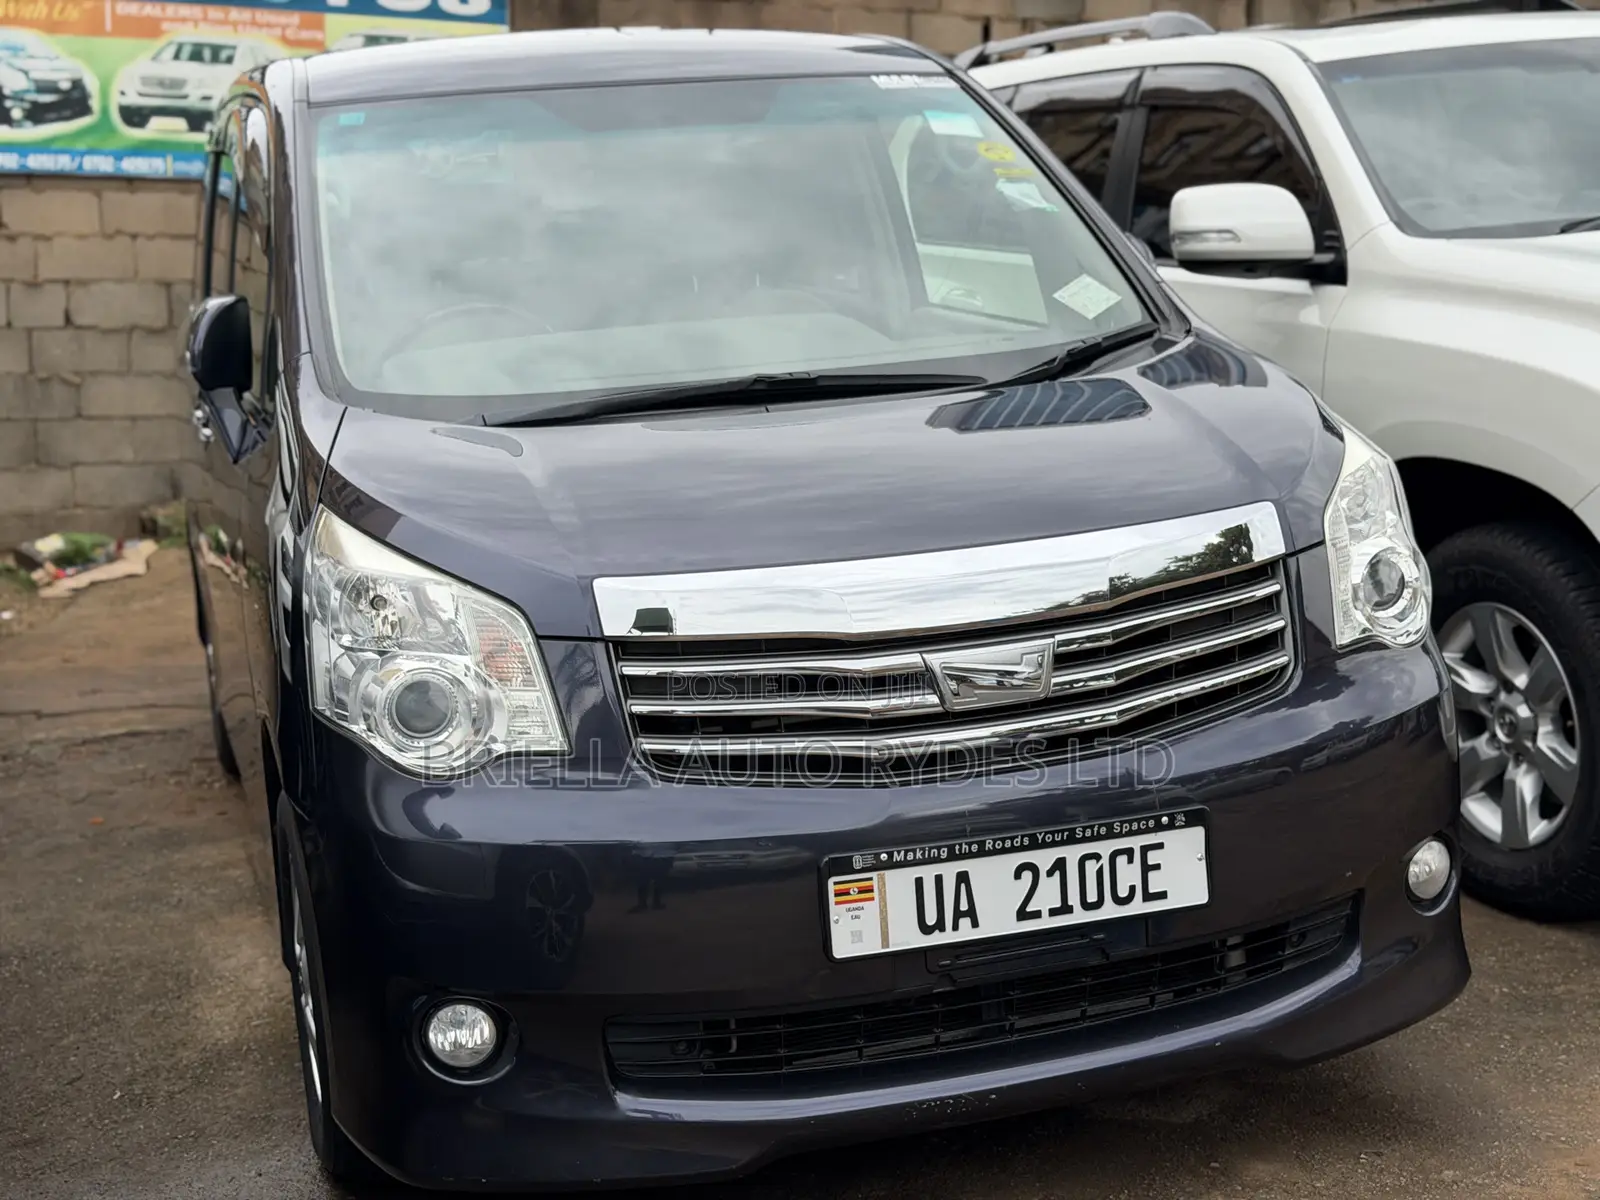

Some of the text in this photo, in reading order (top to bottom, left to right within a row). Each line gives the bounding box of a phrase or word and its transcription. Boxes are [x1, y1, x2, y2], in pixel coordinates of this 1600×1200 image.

[893, 847, 948, 863] Making
[955, 843, 979, 854] the
[985, 836, 1030, 851] Roads
[1037, 830, 1069, 844] Your
[1075, 825, 1107, 838] Safe
[1113, 818, 1155, 834] Space
[914, 841, 1168, 935] UA 210CE
